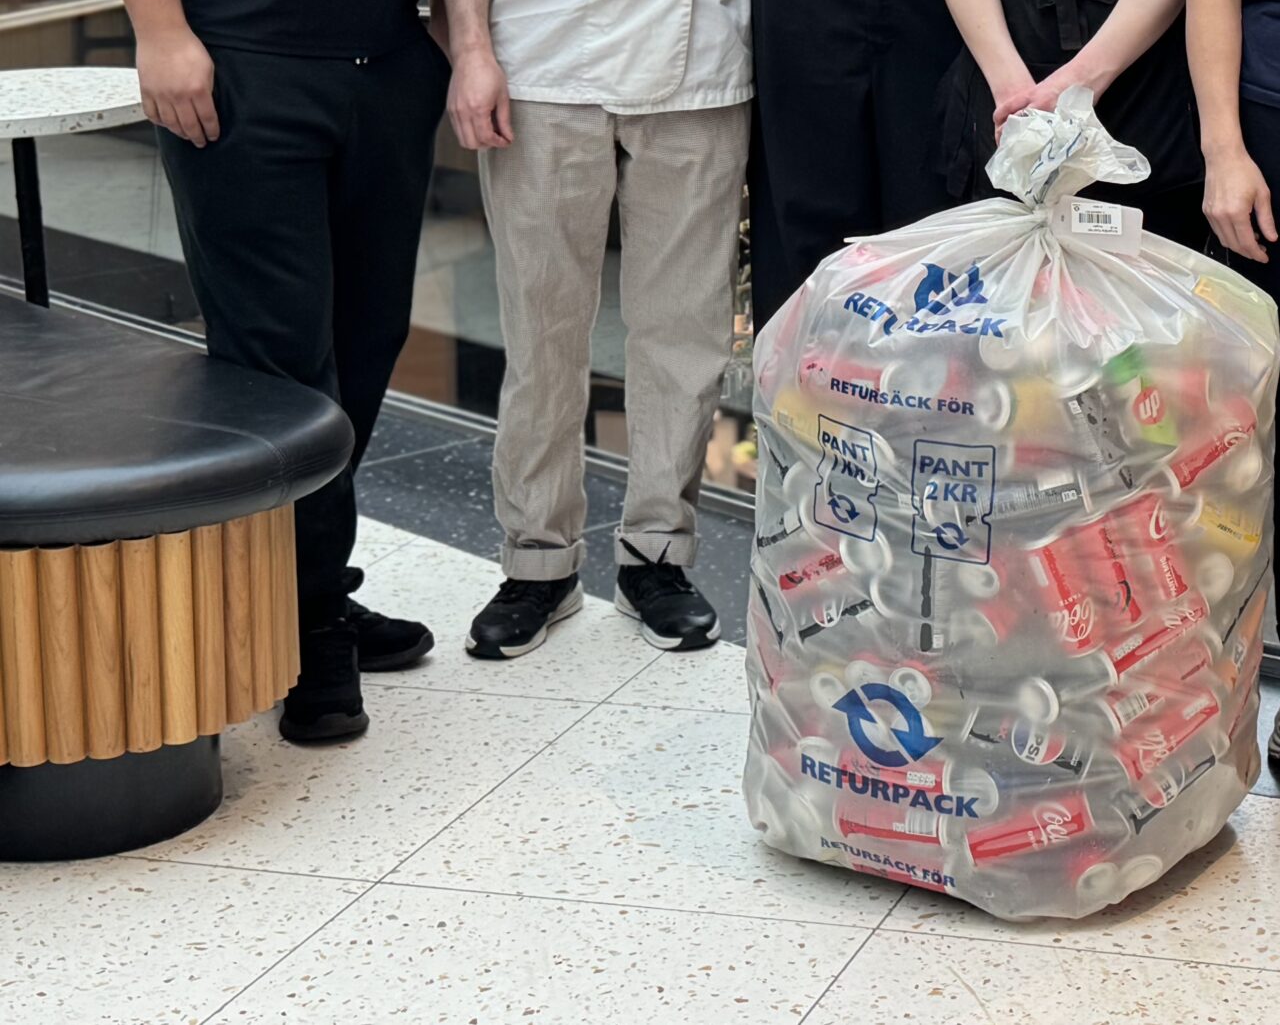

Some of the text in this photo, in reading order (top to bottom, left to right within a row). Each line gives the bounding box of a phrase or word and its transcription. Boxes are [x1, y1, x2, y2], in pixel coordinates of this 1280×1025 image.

[830, 377, 975, 415] RETURSÄCK FÖR
[822, 431, 869, 462] PANT
[919, 455, 989, 478] PANT
[925, 481, 977, 503] 2 KR
[1023, 735, 1044, 762] PSI
[801, 753, 980, 818] RETURPACK
[820, 836, 956, 887] RETURSÄCK FÖR
